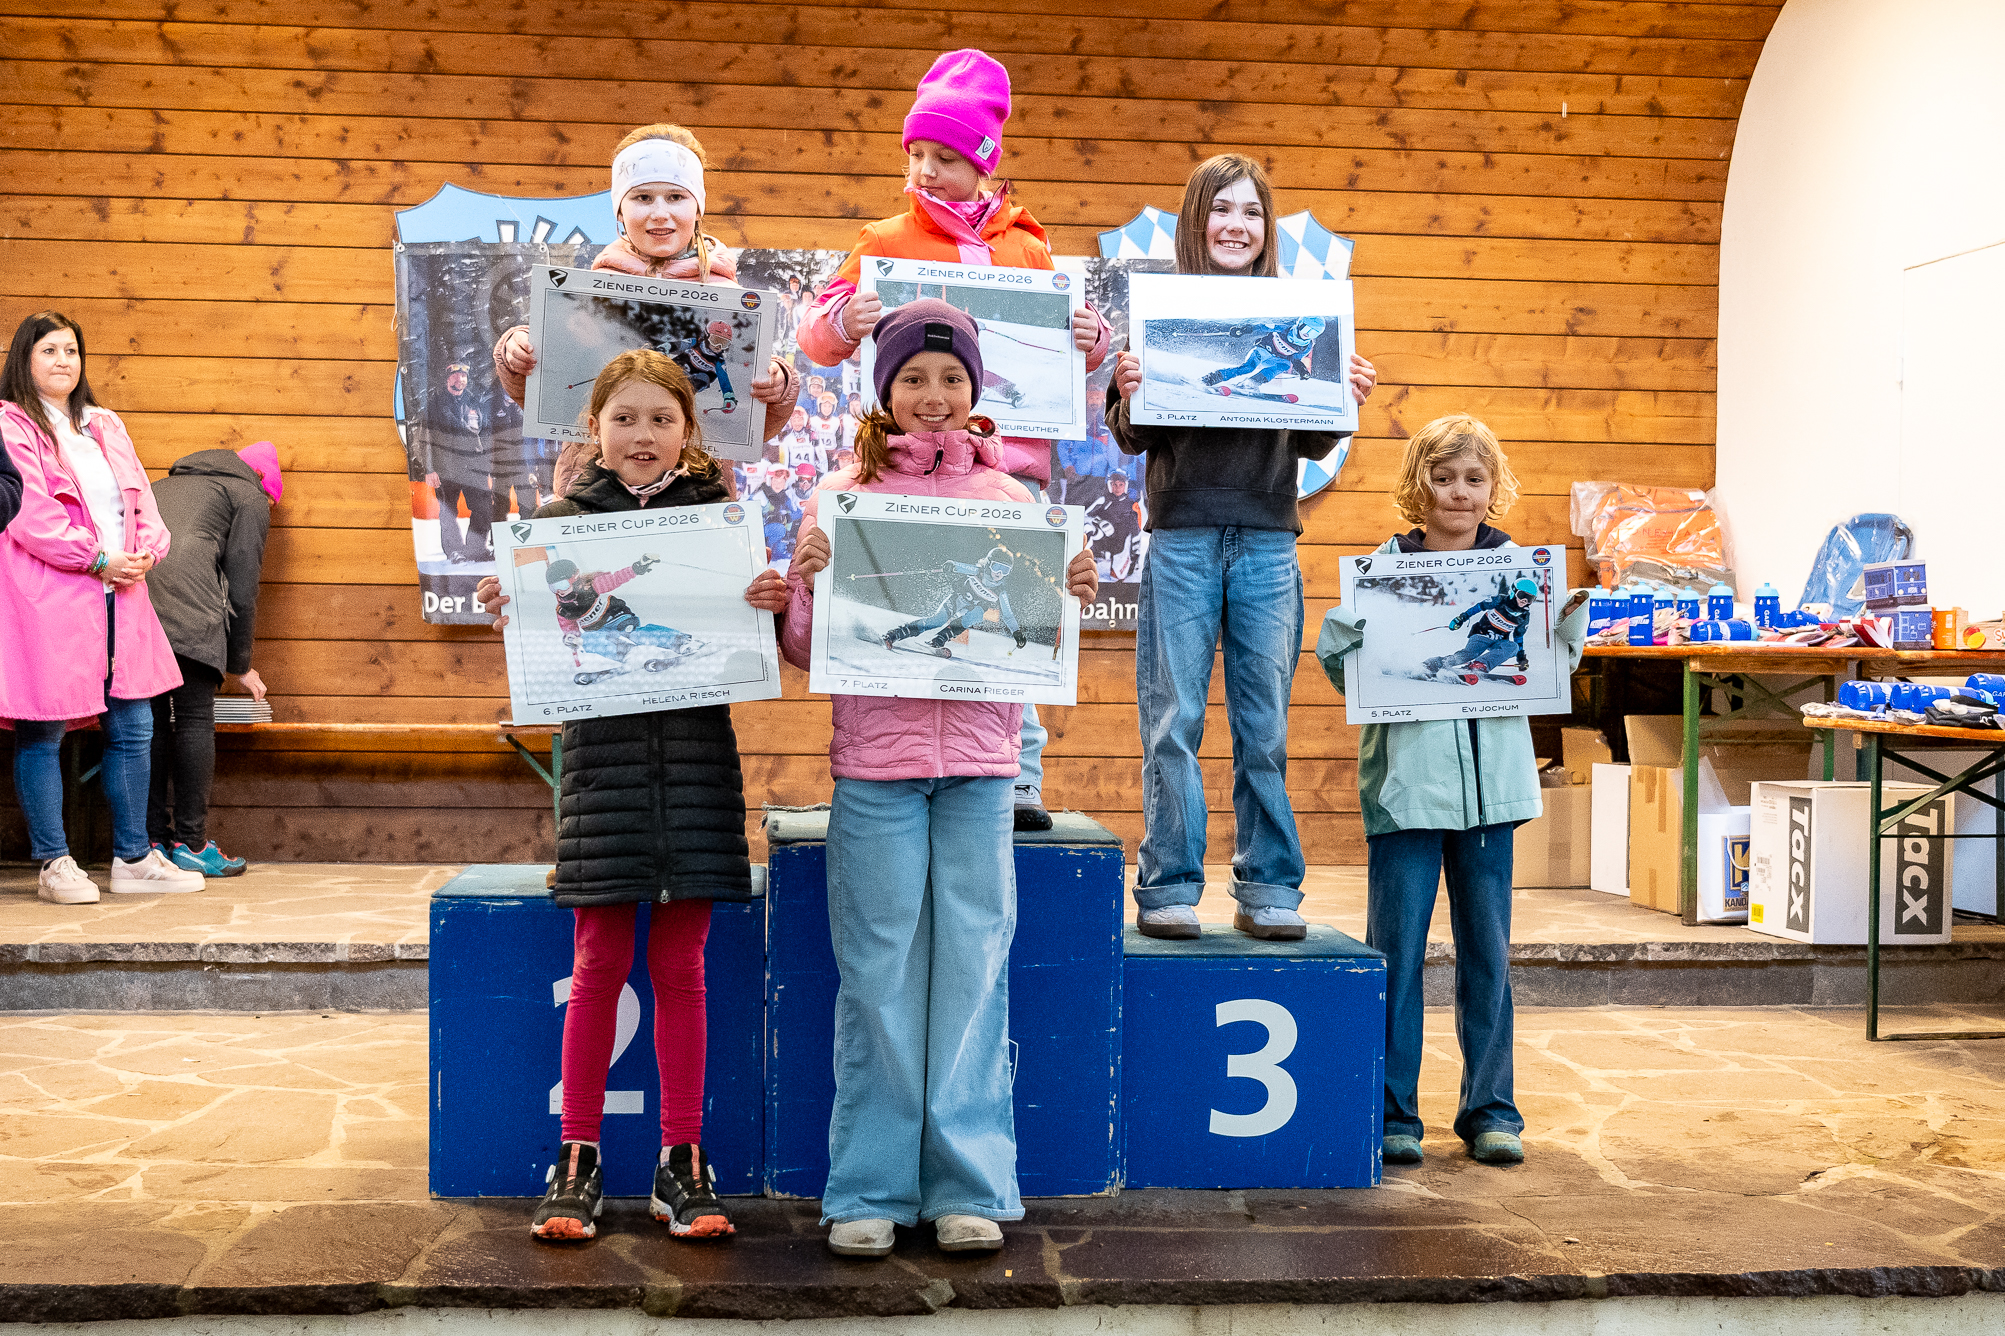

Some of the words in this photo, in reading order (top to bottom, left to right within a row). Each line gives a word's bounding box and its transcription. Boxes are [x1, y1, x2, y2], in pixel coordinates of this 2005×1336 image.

[917, 267, 964, 279] ZIENER
[967, 271, 996, 282] CUP
[998, 274, 1033, 285] 2026
[592, 279, 644, 294] ZIENER
[647, 285, 678, 298] CUP
[681, 289, 719, 302] 2026
[1167, 413, 1198, 421] PLATZ
[1219, 415, 1262, 424] ANTONIA
[1263, 416, 1334, 425] KLOSTERMANN
[550, 427, 559, 435] 2.
[884, 502, 940, 516] ZIENER
[980, 508, 1022, 520] 2026
[560, 521, 618, 536] ZIENER
[621, 518, 655, 530] CUP
[658, 513, 700, 527] 2026
[1396, 559, 1443, 570] ZIENER
[1446, 557, 1474, 567] CUP
[1477, 555, 1512, 565] 2026
[425, 591, 465, 613] Der
[1081, 597, 1138, 620] bahn
[840, 679, 850, 688] 7.
[853, 680, 888, 690] PLATZ
[939, 684, 981, 694] CARINA
[984, 686, 1025, 696] RIEGER
[642, 695, 688, 705] HELENA
[689, 689, 731, 700] RIESCH
[543, 707, 554, 716] 6.
[557, 704, 593, 714] PLATZ
[1382, 709, 1412, 717] PLATZ
[1479, 704, 1519, 712] JOCHUM
[1789, 806, 1809, 924] Tacx
[1902, 808, 1938, 926] Tacx
[1209, 998, 1298, 1137] 3
